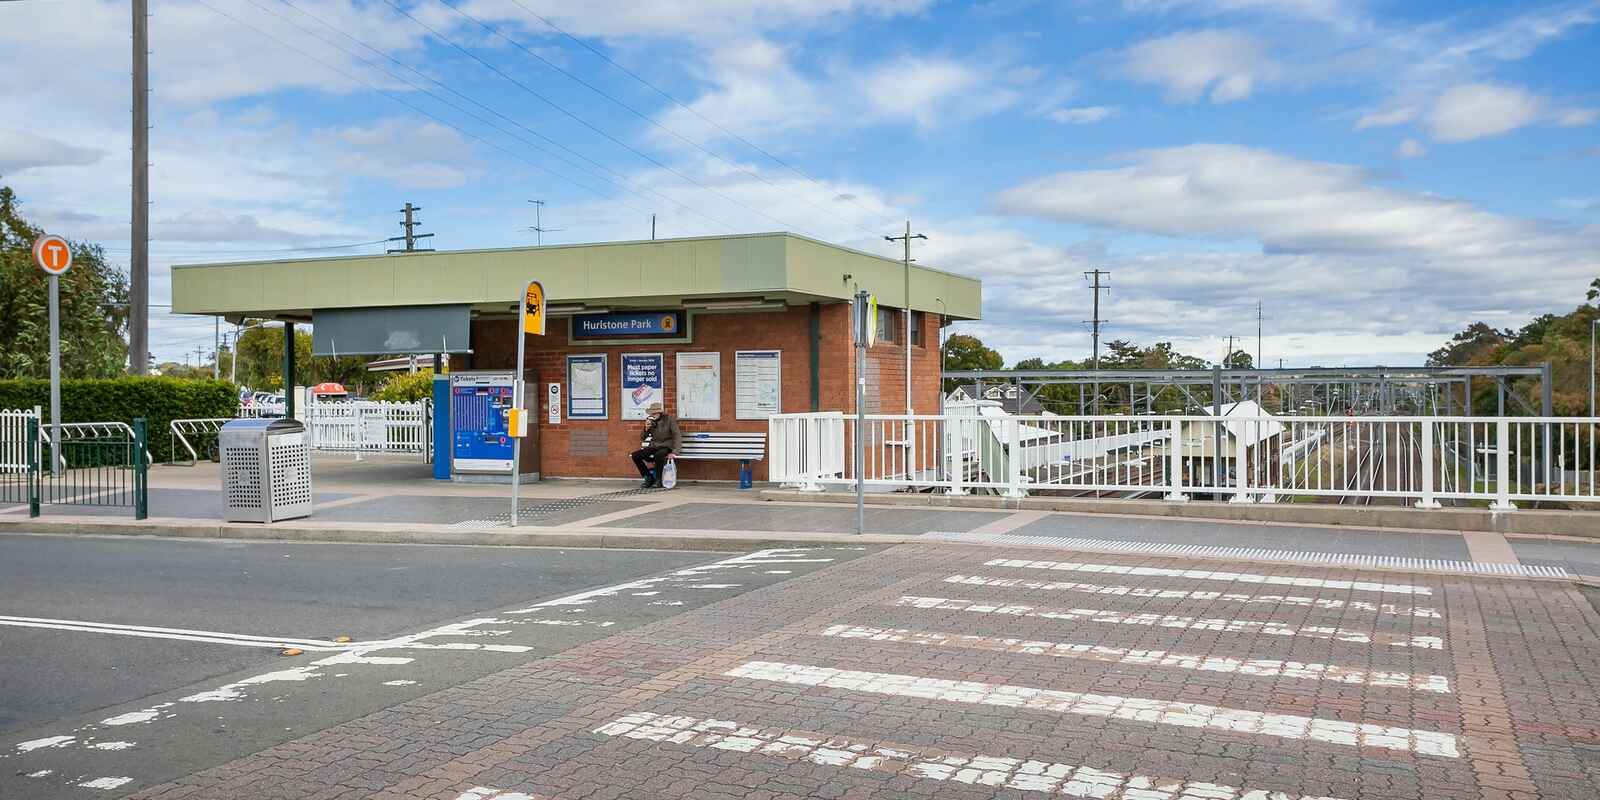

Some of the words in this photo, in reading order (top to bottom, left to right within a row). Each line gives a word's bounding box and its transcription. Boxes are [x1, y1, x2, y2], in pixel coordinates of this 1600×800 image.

[47, 245, 65, 266] T
[583, 319, 629, 330] Hurlstone
[631, 319, 652, 329] Park
